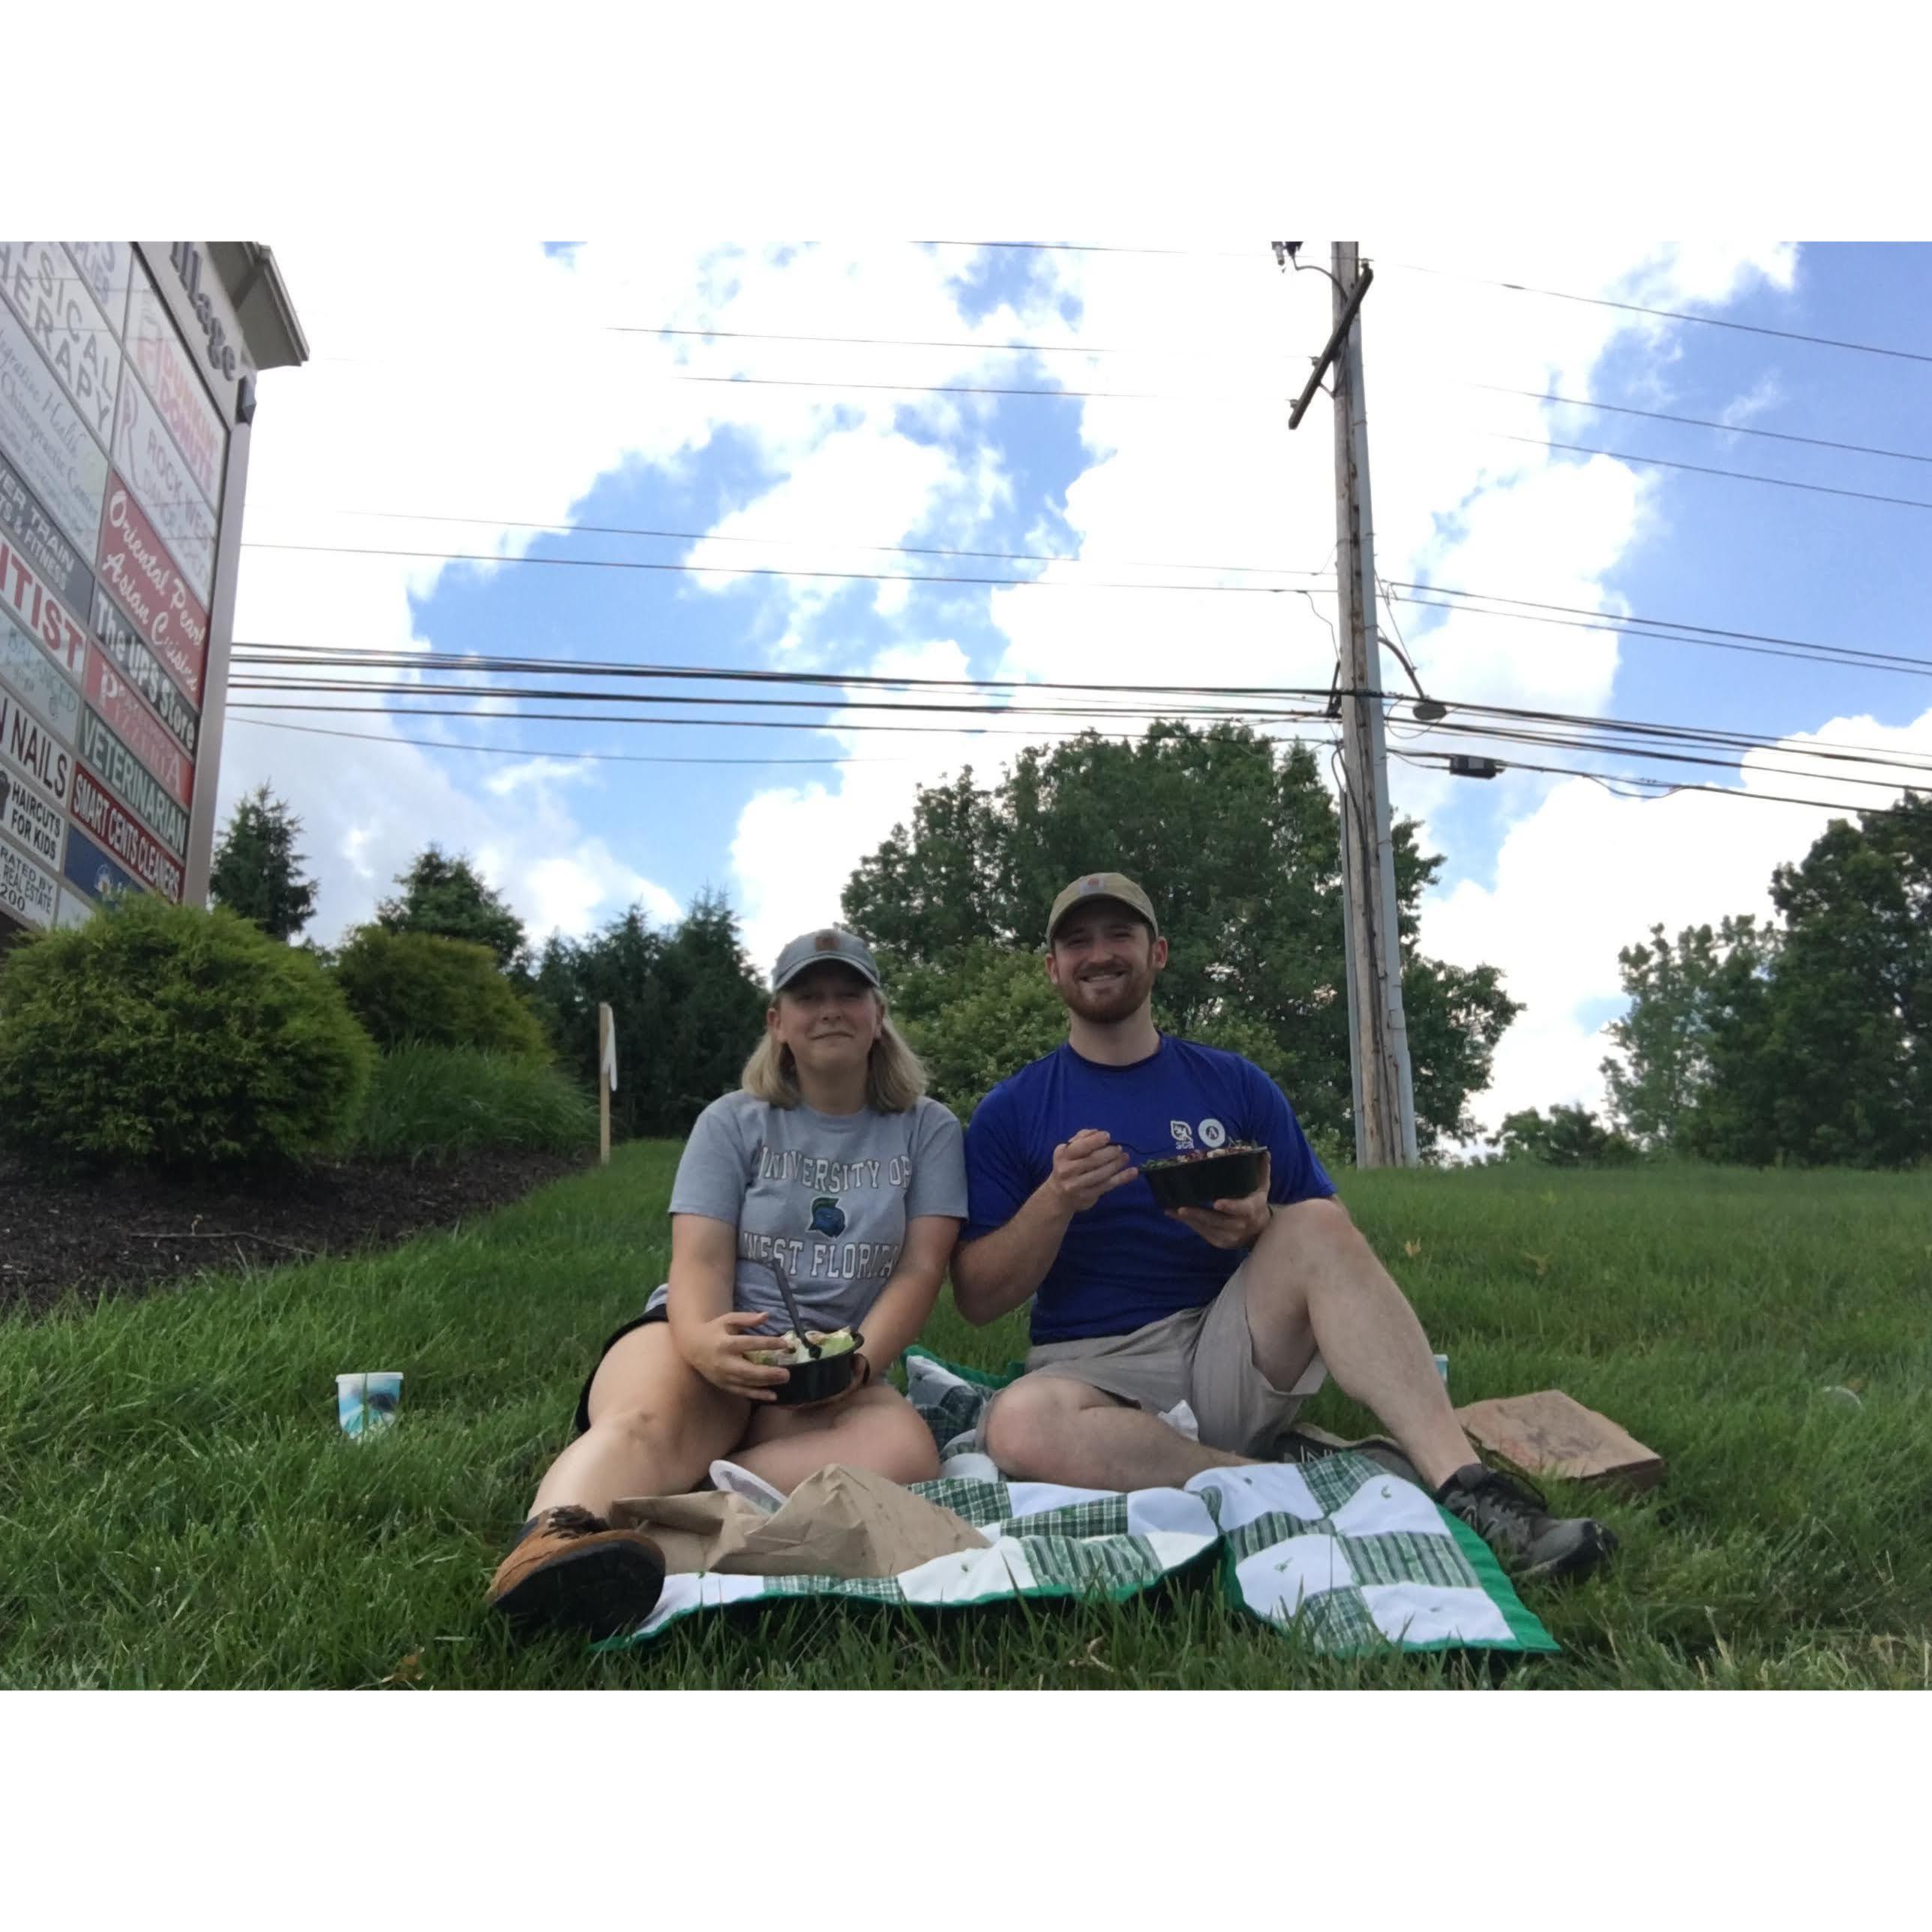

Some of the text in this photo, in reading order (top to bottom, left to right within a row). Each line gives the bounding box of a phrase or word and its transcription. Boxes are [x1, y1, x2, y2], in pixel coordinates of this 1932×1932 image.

[32, 506, 74, 572] TRAIN
[110, 490, 170, 596] Oriental
[171, 578, 206, 646] Pearl
[102, 553, 148, 625] Asian
[97, 592, 125, 662] The
[128, 635, 159, 704] UPS
[160, 678, 194, 750] Store
[10, 707, 68, 799] NAILS
[84, 710, 187, 856] VETERINARIAN
[10, 808, 56, 861] FOR KIDS
[12, 781, 61, 838] HAIRCUTS
[74, 773, 181, 904] SMART CENTS CLEANERS
[1, 845, 36, 883] RATED
[3, 863, 52, 915] REAL ESTATE
[888, 1155, 913, 1189] OF
[742, 1232, 804, 1276] WEST
